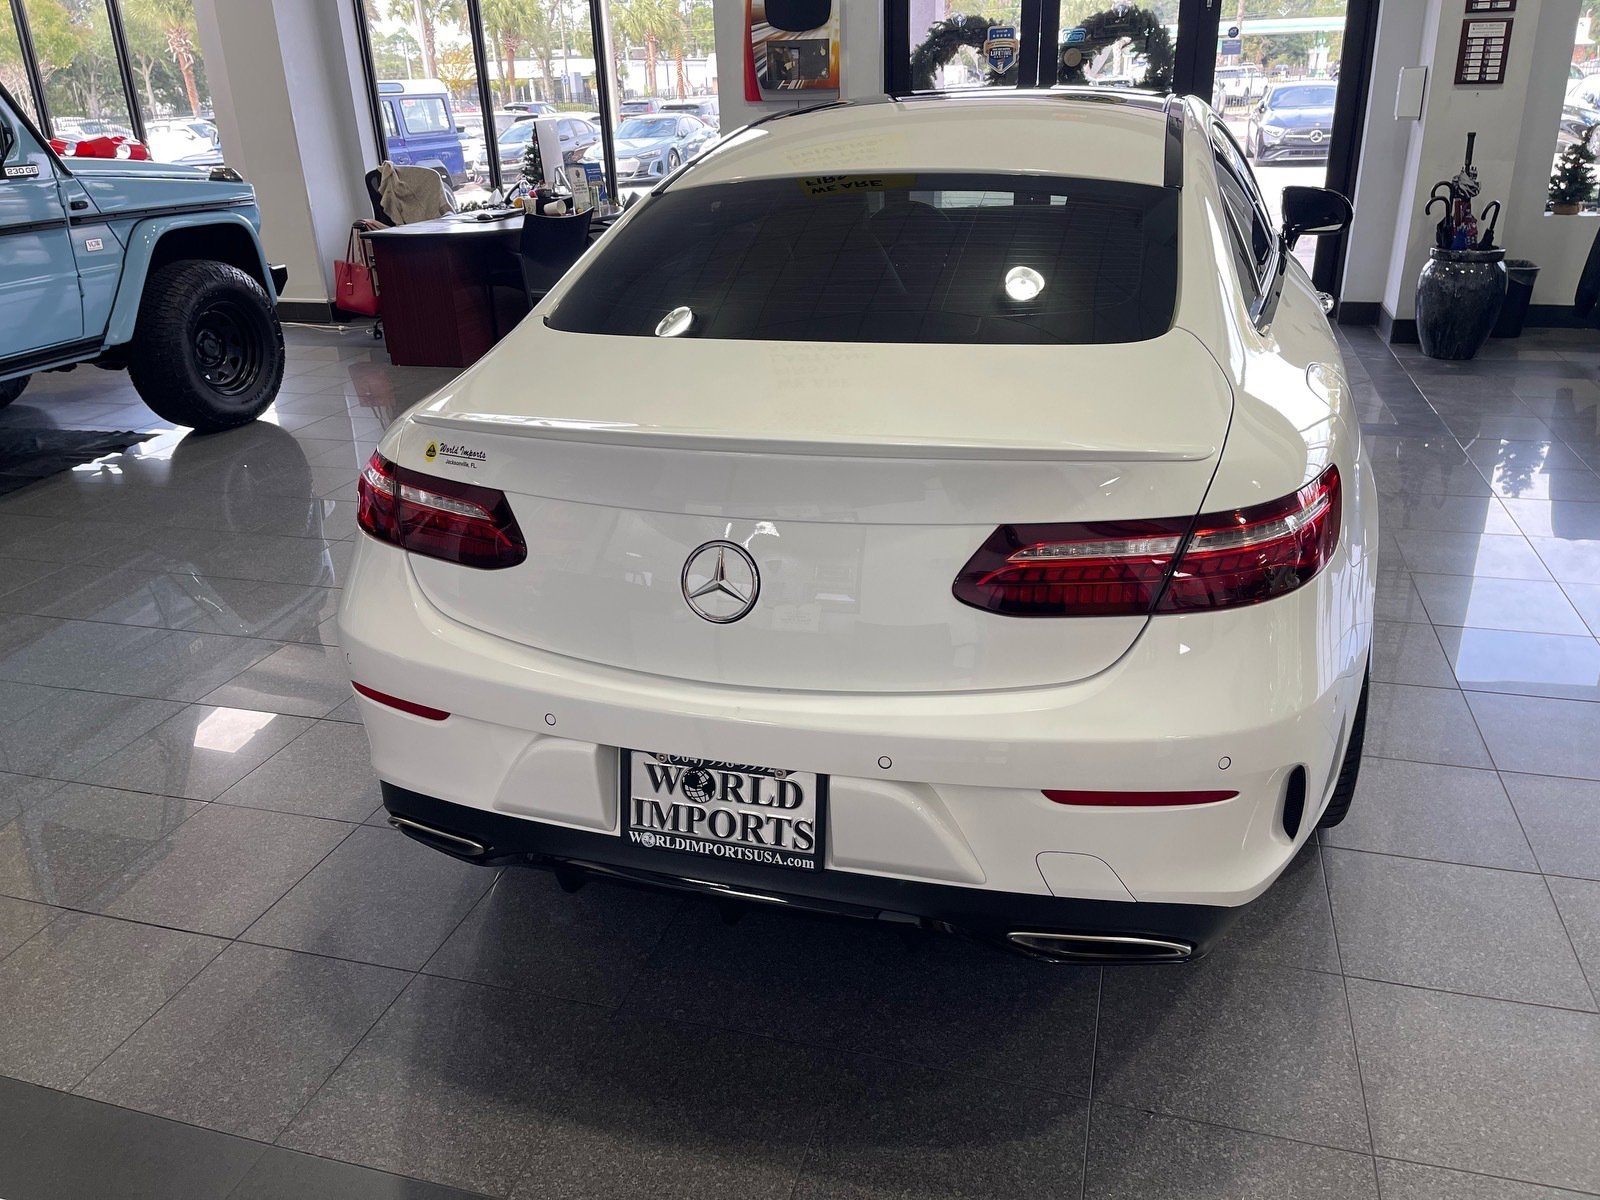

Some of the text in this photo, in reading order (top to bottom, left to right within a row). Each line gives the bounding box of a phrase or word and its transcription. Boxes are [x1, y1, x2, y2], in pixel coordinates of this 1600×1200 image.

[7, 167, 25, 175] 230
[440, 443, 486, 459] World Imports
[632, 797, 814, 851] IMPORTS
[628, 830, 815, 870] WORLDIMPORTSUSA.com
